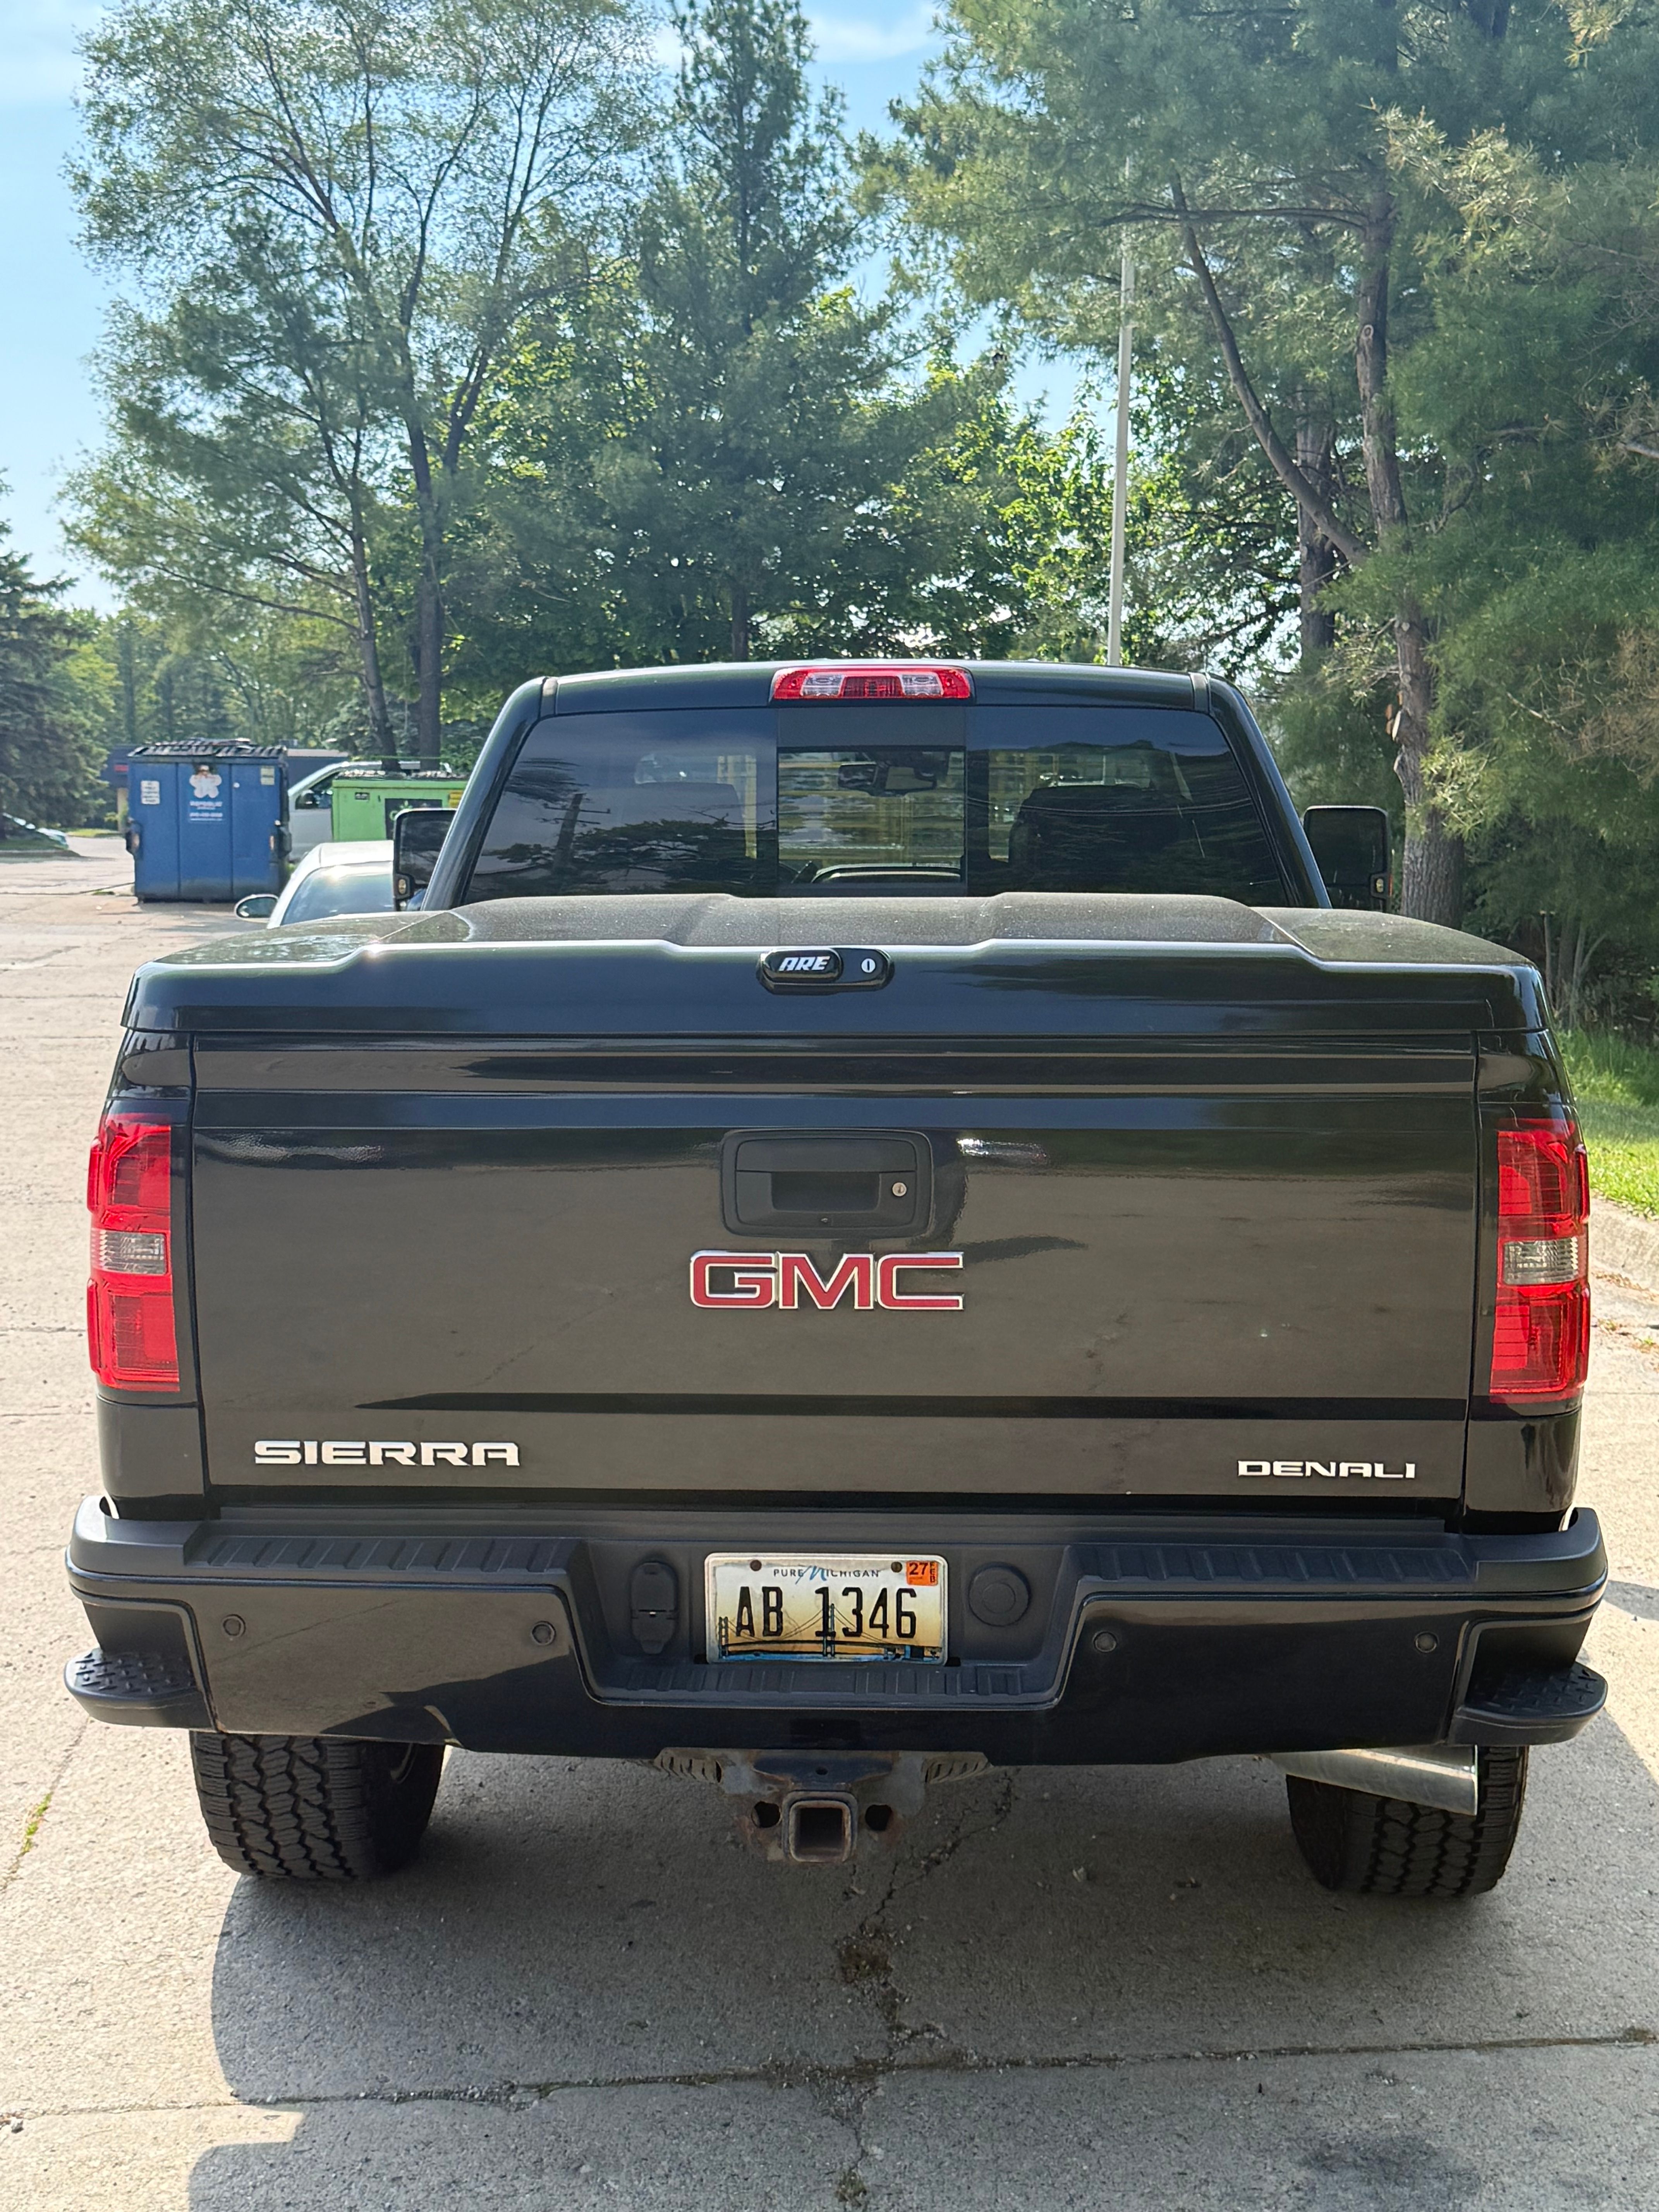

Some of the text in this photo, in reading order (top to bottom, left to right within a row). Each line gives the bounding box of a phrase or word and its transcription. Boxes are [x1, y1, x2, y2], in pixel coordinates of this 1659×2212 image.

[778, 956, 830, 971] ARE
[690, 1250, 964, 1310] GMC
[254, 1441, 520, 1467] SIERRA
[1238, 1460, 1415, 1479] DENALI
[774, 1565, 881, 1585] PURE MICHIGAN
[909, 1562, 929, 1575] 27
[735, 1586, 917, 1638] AB 1346
